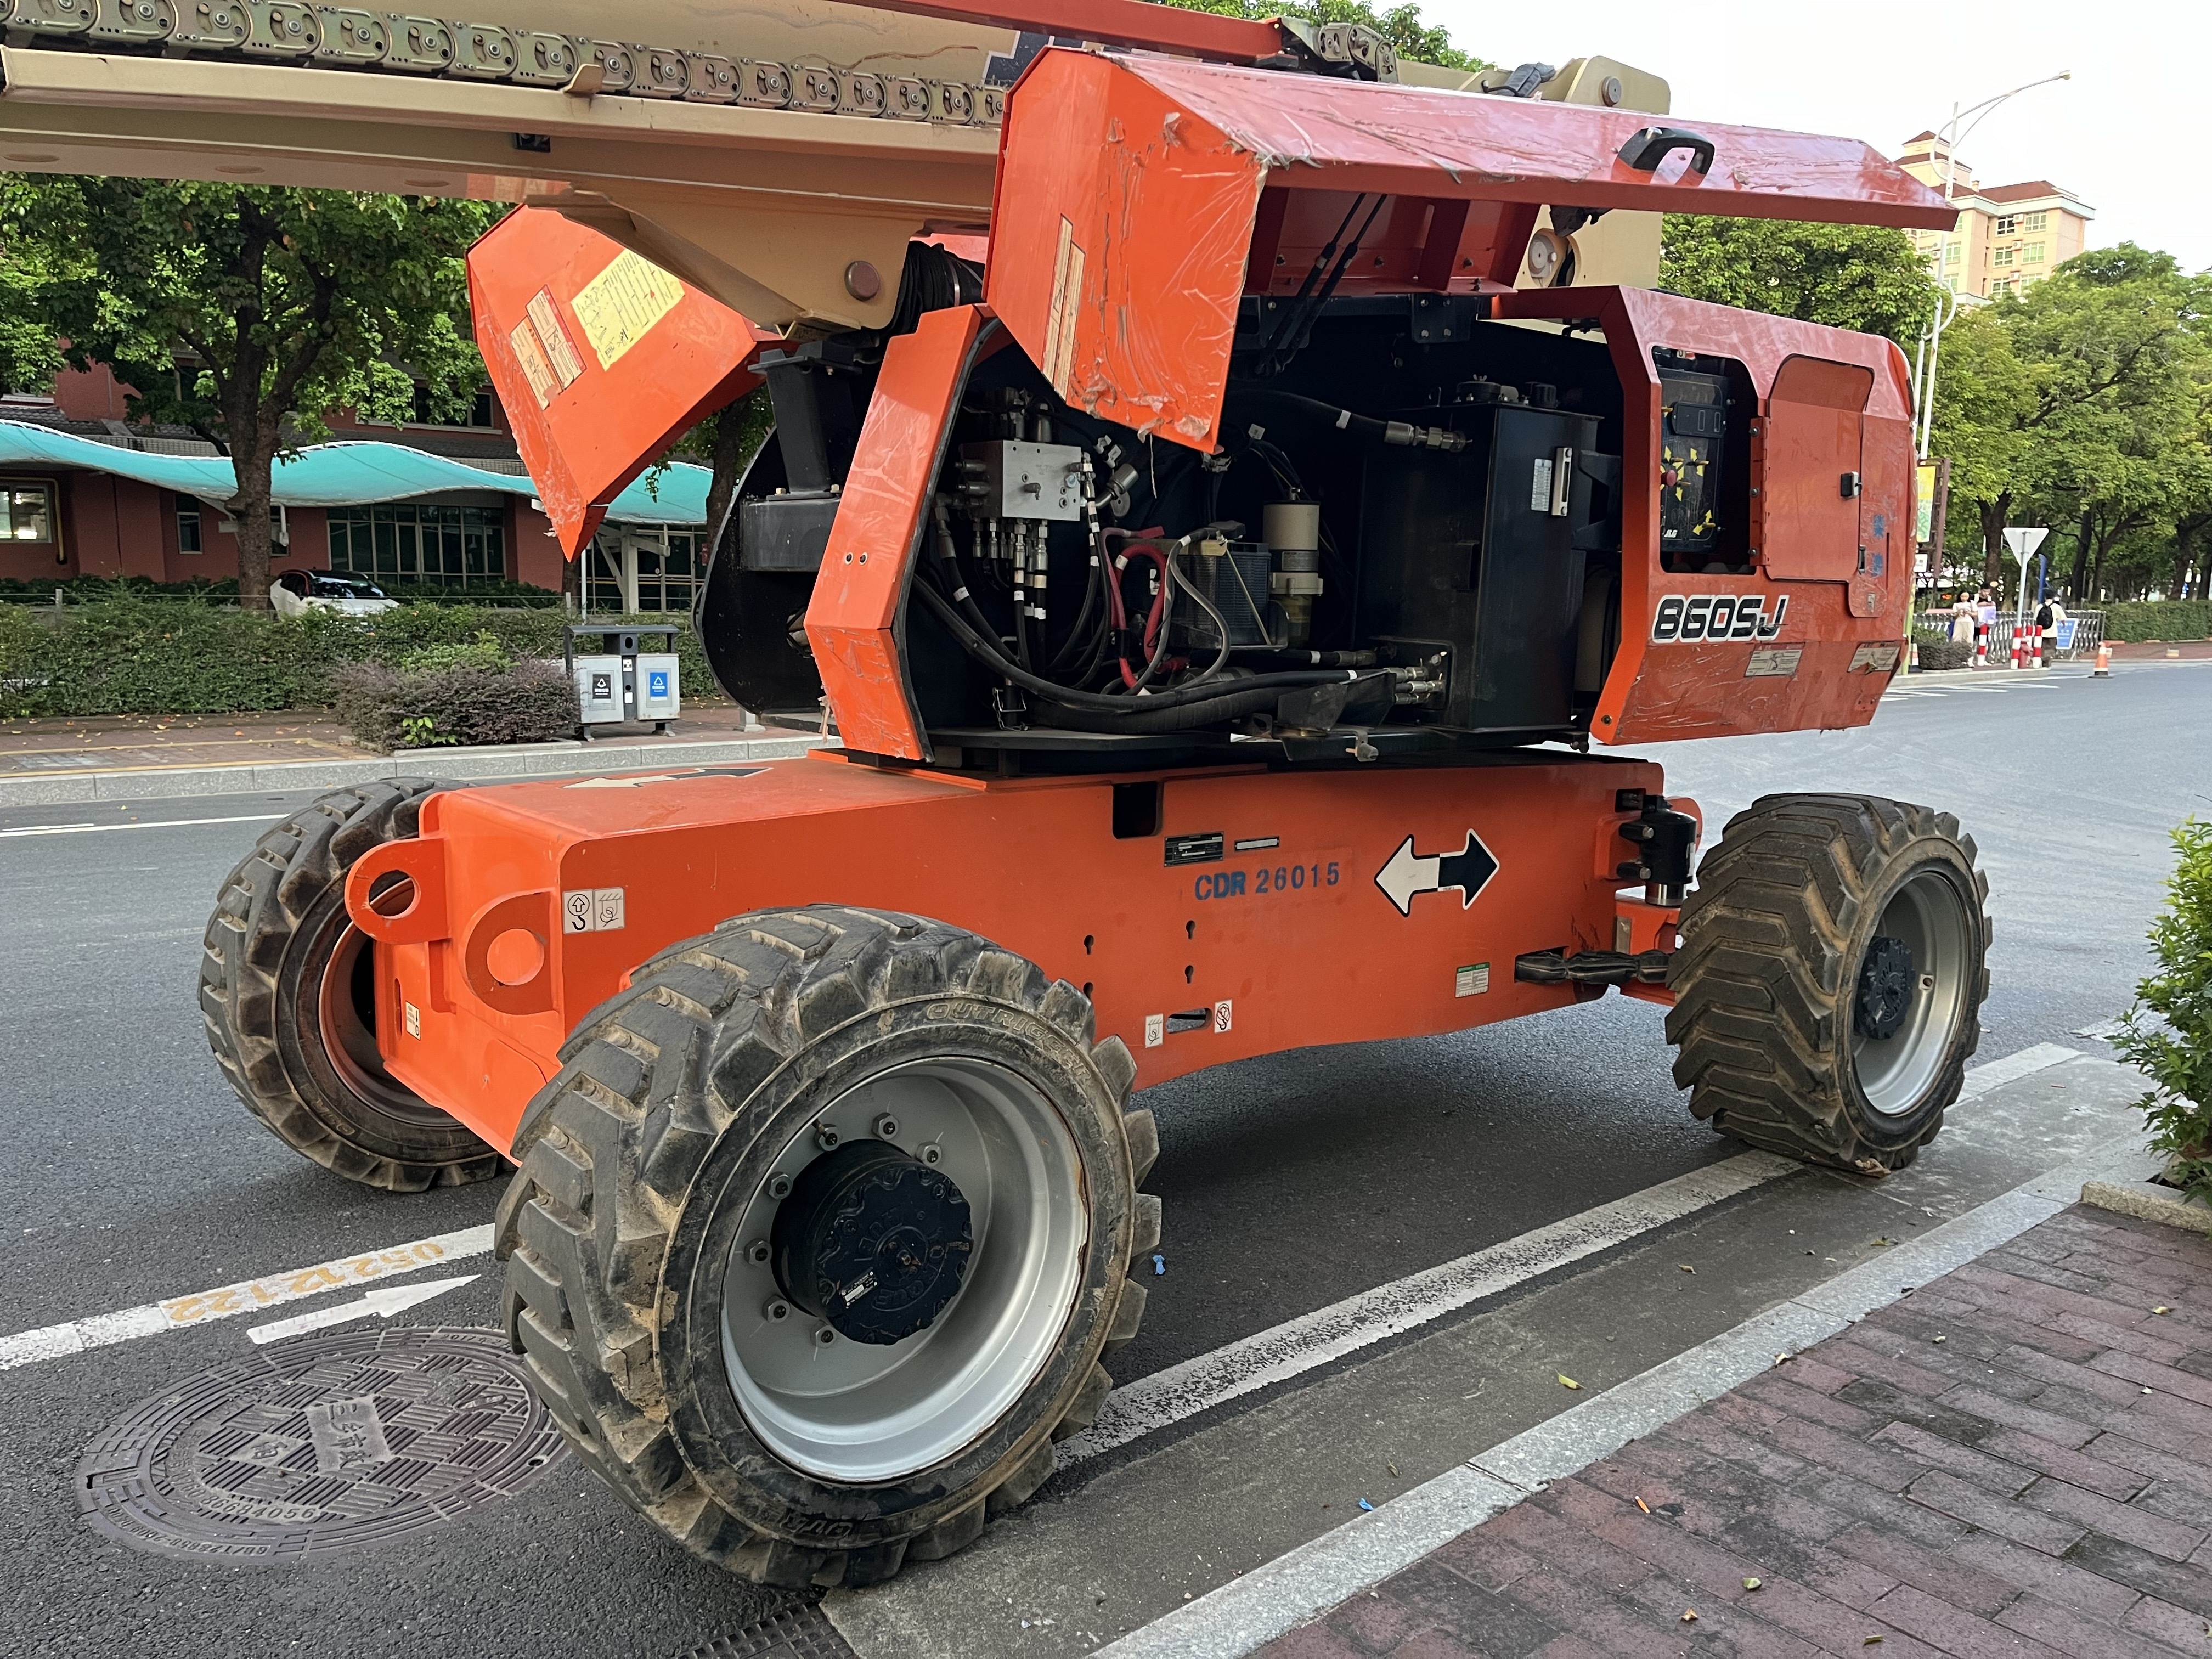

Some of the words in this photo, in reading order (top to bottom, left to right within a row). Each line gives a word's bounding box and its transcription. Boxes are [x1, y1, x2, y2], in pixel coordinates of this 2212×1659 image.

[1652, 594, 1790, 644] 860SJ
[1195, 871, 1246, 900] CDR
[1255, 861, 1339, 894] 26015
[927, 1003, 1091, 1080] OUTRIGGER
[200, 1495, 316, 1519] 86684056
